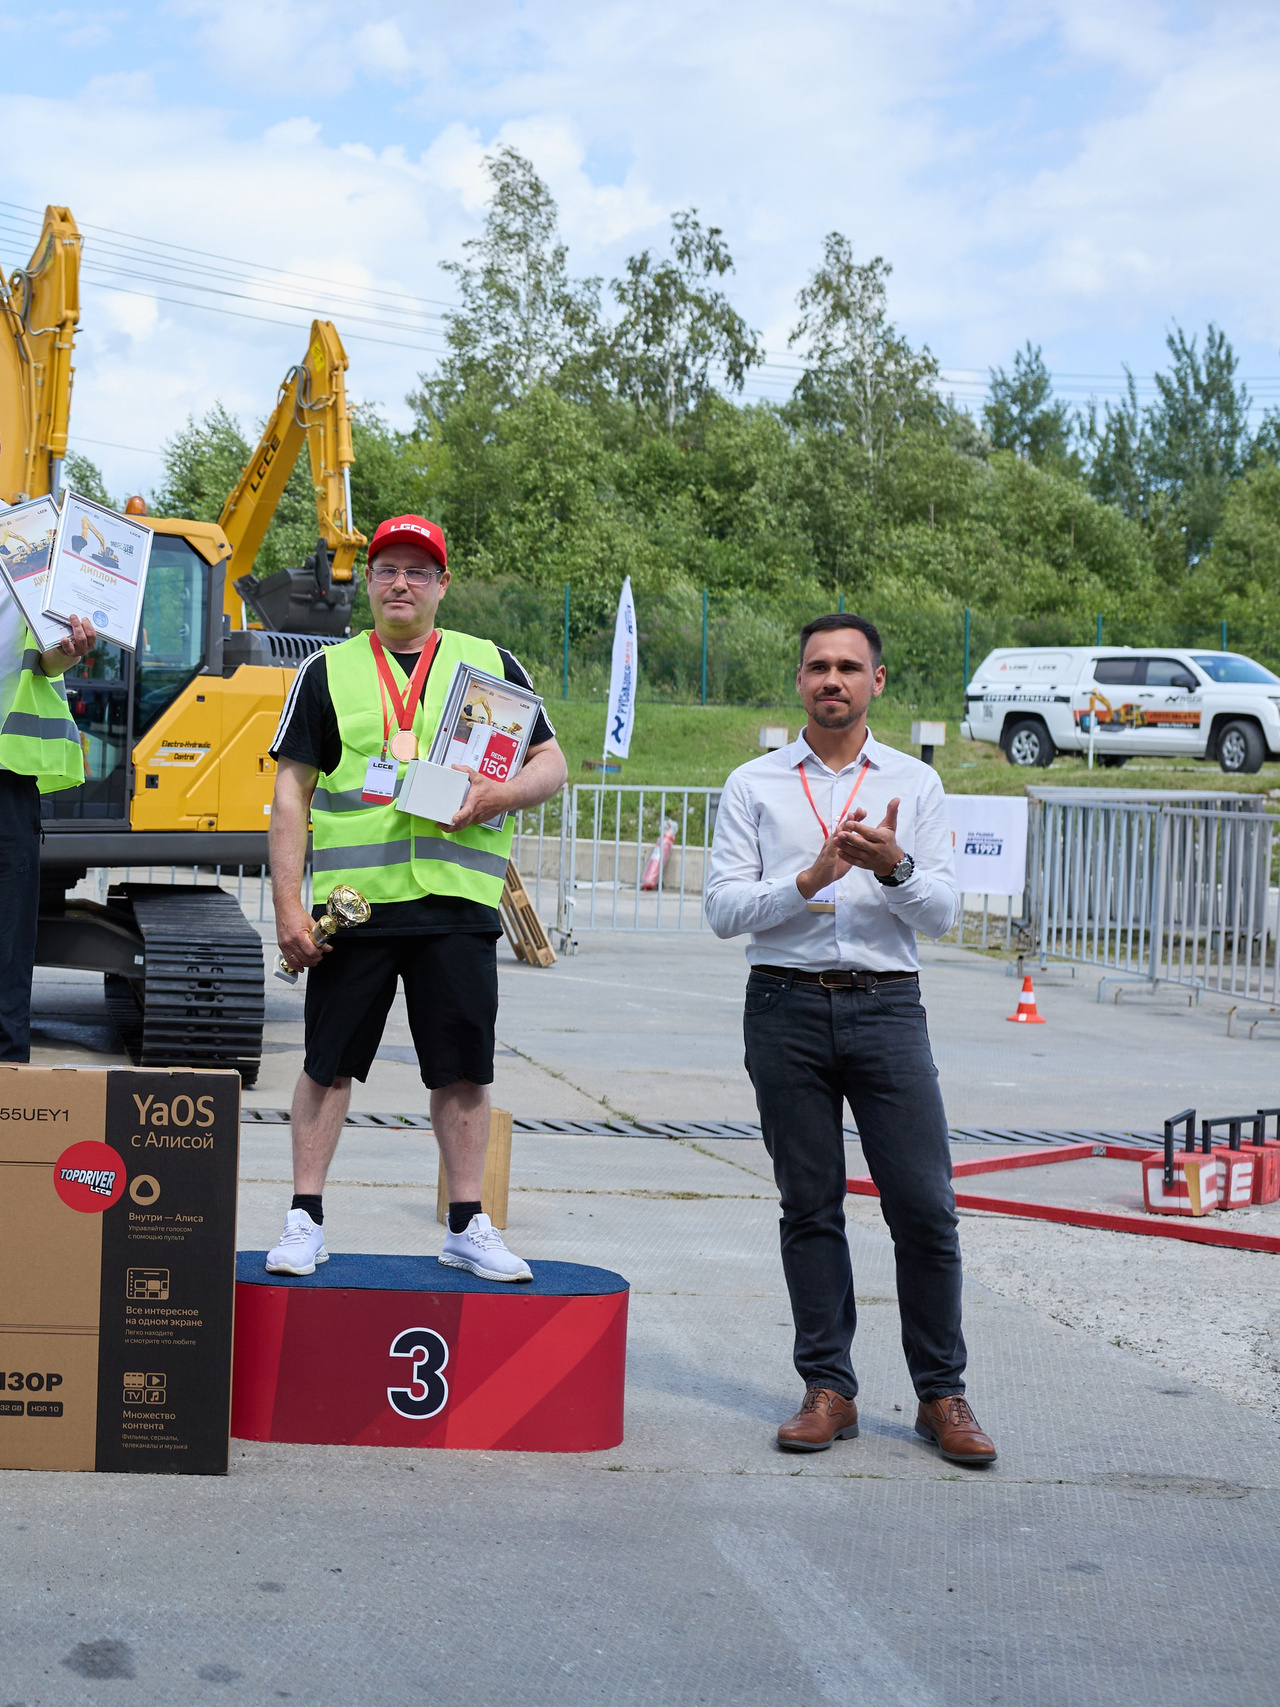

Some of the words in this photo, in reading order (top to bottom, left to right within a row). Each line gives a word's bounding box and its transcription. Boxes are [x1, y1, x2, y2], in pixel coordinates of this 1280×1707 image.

[390, 523, 431, 538] LGCE
[80, 563, 118, 586] ДИПЛОМ
[161, 739, 211, 749] Electro-Hydraulic
[173, 752, 195, 761] Control
[490, 751, 508, 762] REDMI
[482, 757, 508, 779] 15C
[975, 844, 999, 855] 1993
[0, 1107, 69, 1122] 55UEY1
[132, 1093, 216, 1128] YaOS
[145, 1131, 214, 1149] Алисой
[59, 1168, 116, 1190] TOPDRIVER
[128, 1212, 163, 1223] Внутри
[175, 1213, 204, 1223] Алиса
[128, 1224, 165, 1233] Управляйте
[164, 1234, 185, 1242] пульта
[126, 1305, 143, 1315] Все
[145, 1307, 199, 1317] интересное
[138, 1318, 169, 1327] одном
[170, 1320, 203, 1328] экране
[130, 1337, 160, 1346] смотрите
[172, 1338, 196, 1346] любите
[387, 1327, 449, 1419] 3
[127, 1391, 141, 1400] TV
[122, 1410, 176, 1420] Множество
[122, 1422, 164, 1431] контента
[122, 1442, 158, 1450] телеканалы
[164, 1443, 188, 1451] музыка
